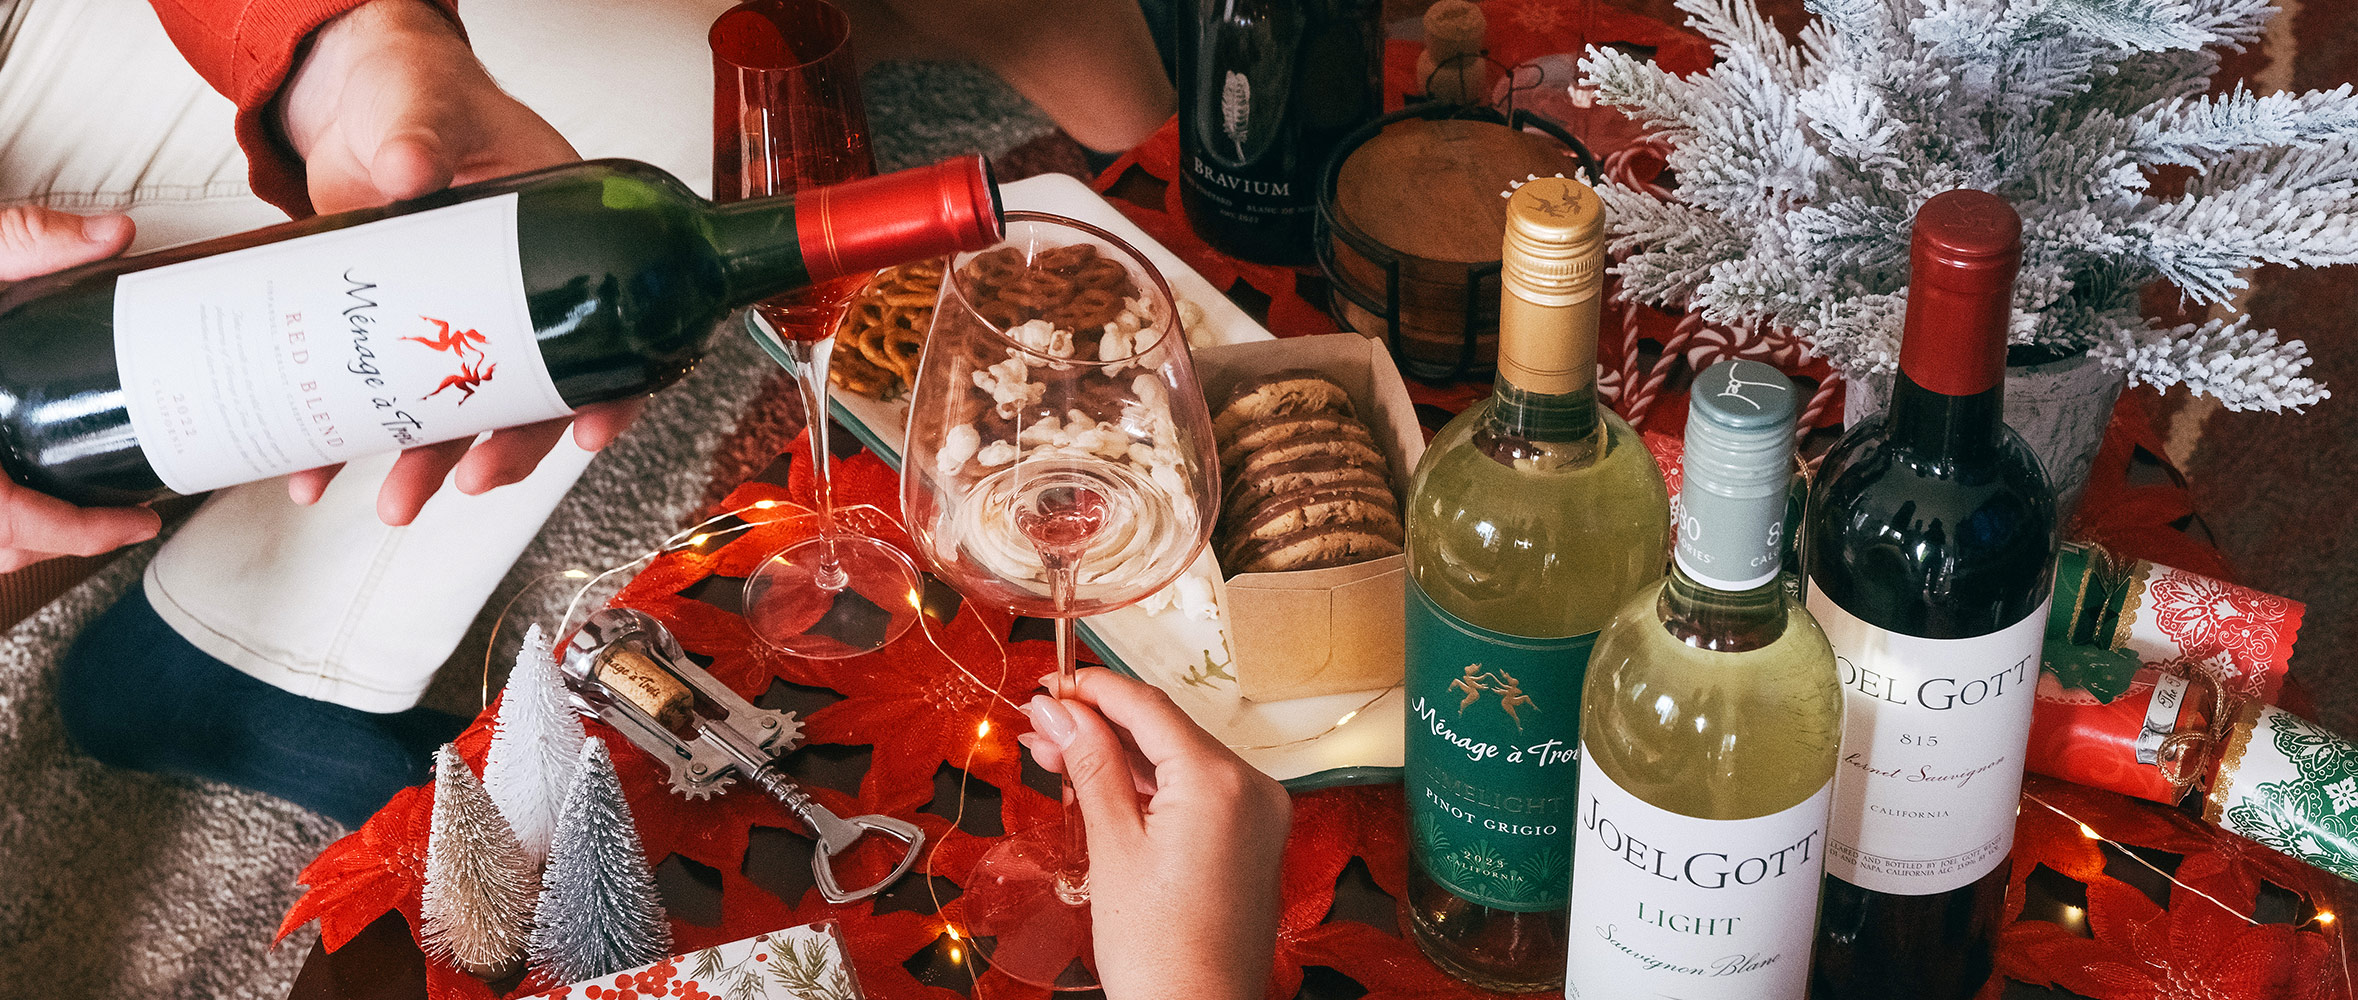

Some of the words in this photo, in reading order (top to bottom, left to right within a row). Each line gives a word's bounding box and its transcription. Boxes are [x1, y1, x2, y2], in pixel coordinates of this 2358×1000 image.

[1194, 156, 1290, 197] BRAVIUM
[343, 267, 384, 388] Ménage
[372, 397, 396, 411] à
[286, 312, 309, 365] RED
[301, 381, 344, 448] BLEND
[173, 393, 198, 437] 2022
[1834, 650, 1907, 705] OEL
[1917, 653, 2032, 711] GOTT
[2158, 689, 2178, 709] The
[1411, 697, 1499, 762] Ménage
[1507, 745, 1523, 764] à
[1900, 733, 1938, 748] 815
[1844, 753, 1901, 779] bernet
[1906, 756, 2005, 788] Sauvignon
[1426, 787, 1476, 824] PINOT
[1484, 819, 1557, 836] GRIGIO
[1870, 805, 1949, 818] CALIFORNIA
[1446, 855, 1524, 882] CALIFORNIA
[1463, 850, 1504, 869] 2023
[1840, 854, 1858, 866] AND
[1886, 868, 1935, 877] CALIFORNIA
[1863, 856, 1881, 865] AND
[1885, 861, 1923, 869] BOTTLED
[1638, 901, 1741, 936] LIGHT
[1595, 923, 1705, 976] Sauvignon
[1710, 952, 1781, 977] Blanc
